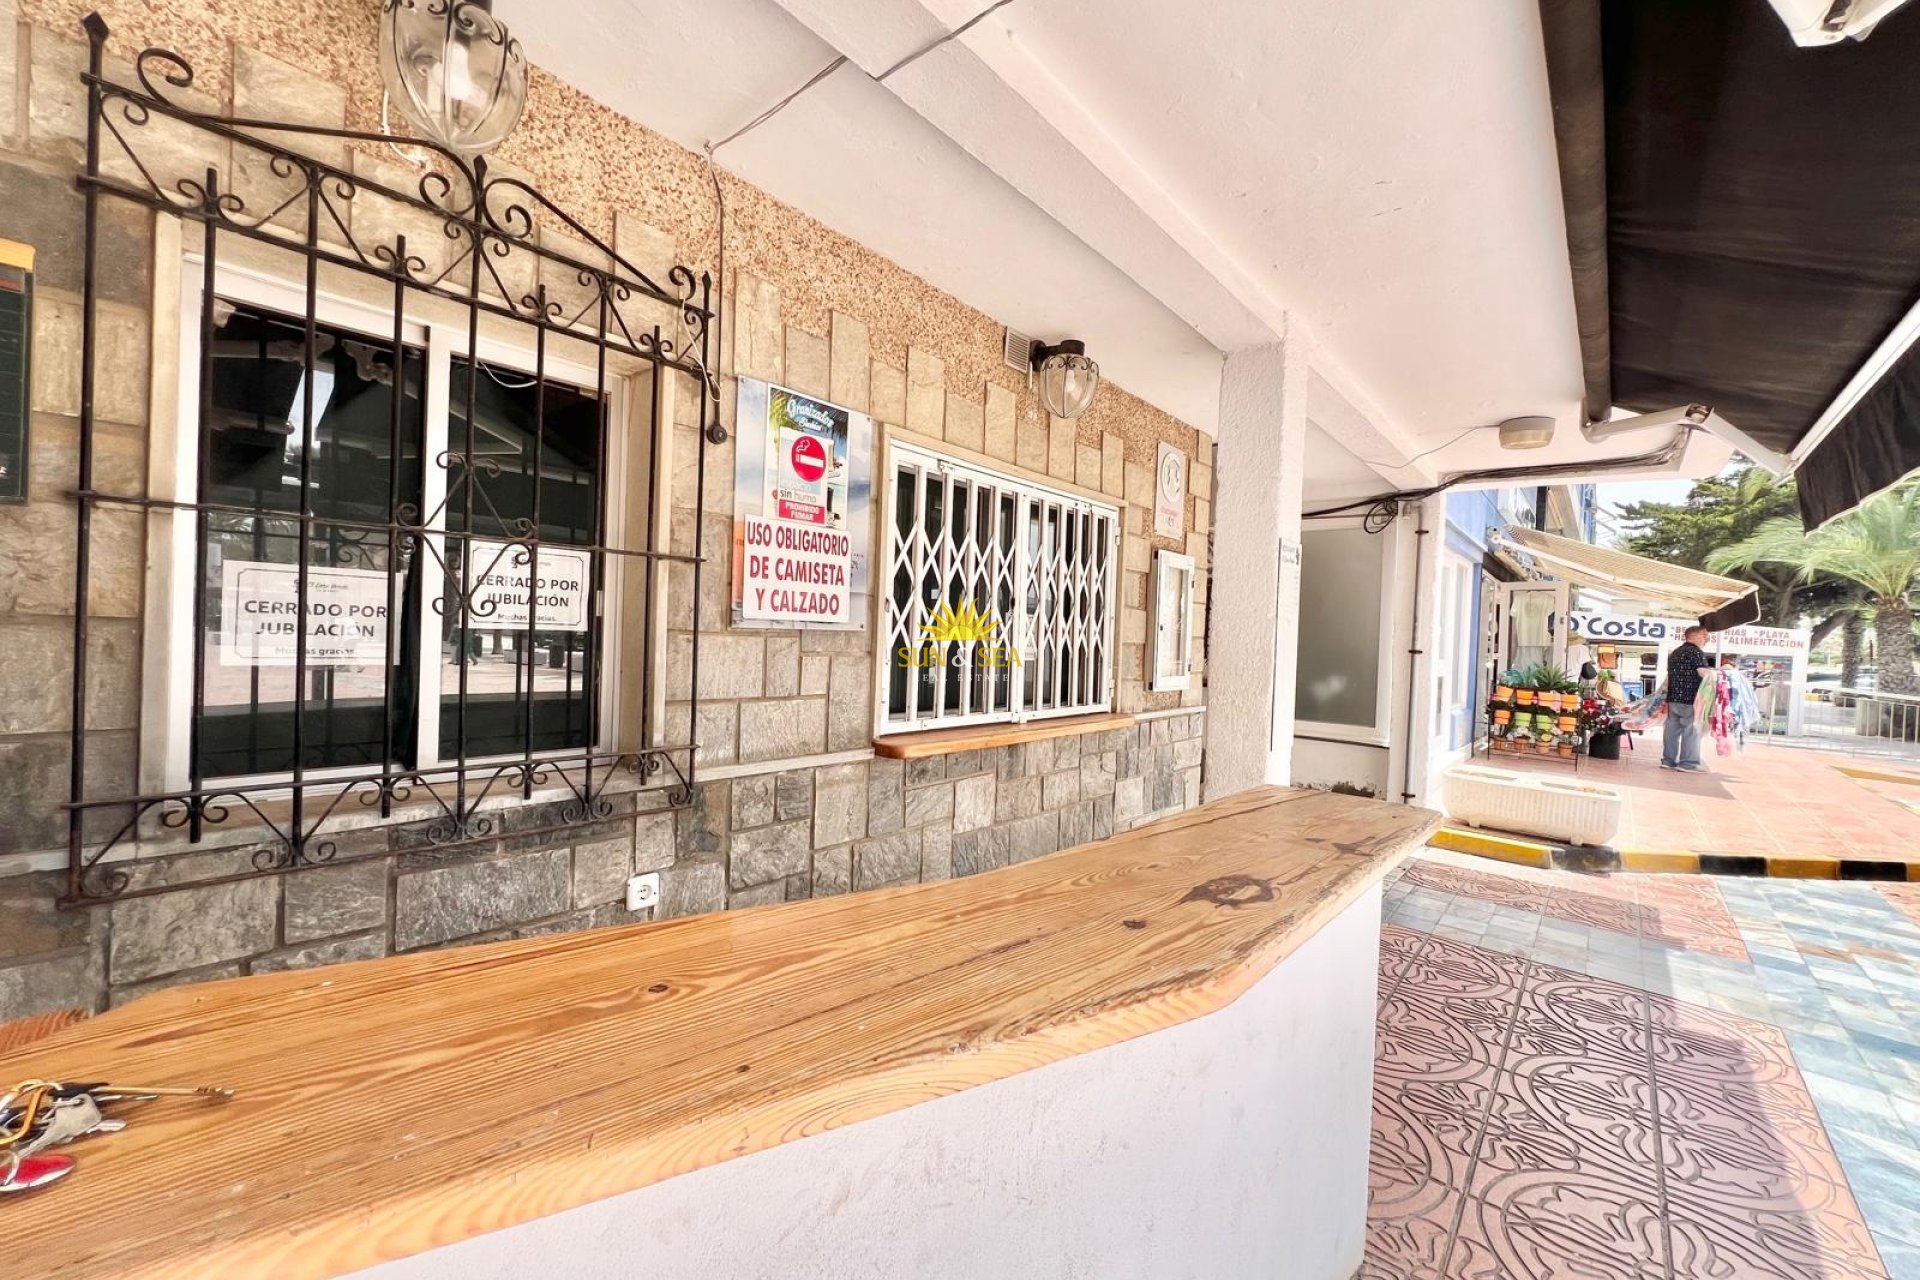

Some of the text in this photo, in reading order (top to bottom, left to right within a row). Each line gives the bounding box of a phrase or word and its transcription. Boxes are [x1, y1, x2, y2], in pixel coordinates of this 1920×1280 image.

[780, 489, 792, 498] sin
[747, 521, 849, 557] USO OBLIGATORIO
[750, 555, 769, 579] DE
[775, 557, 844, 586] CAMISETA
[551, 580, 578, 591] POR
[486, 593, 569, 607] JUBILCIÓN
[755, 588, 839, 615] Y CALZADO
[244, 600, 387, 618] CERRDO POR
[255, 622, 374, 637] JUBACIÓN
